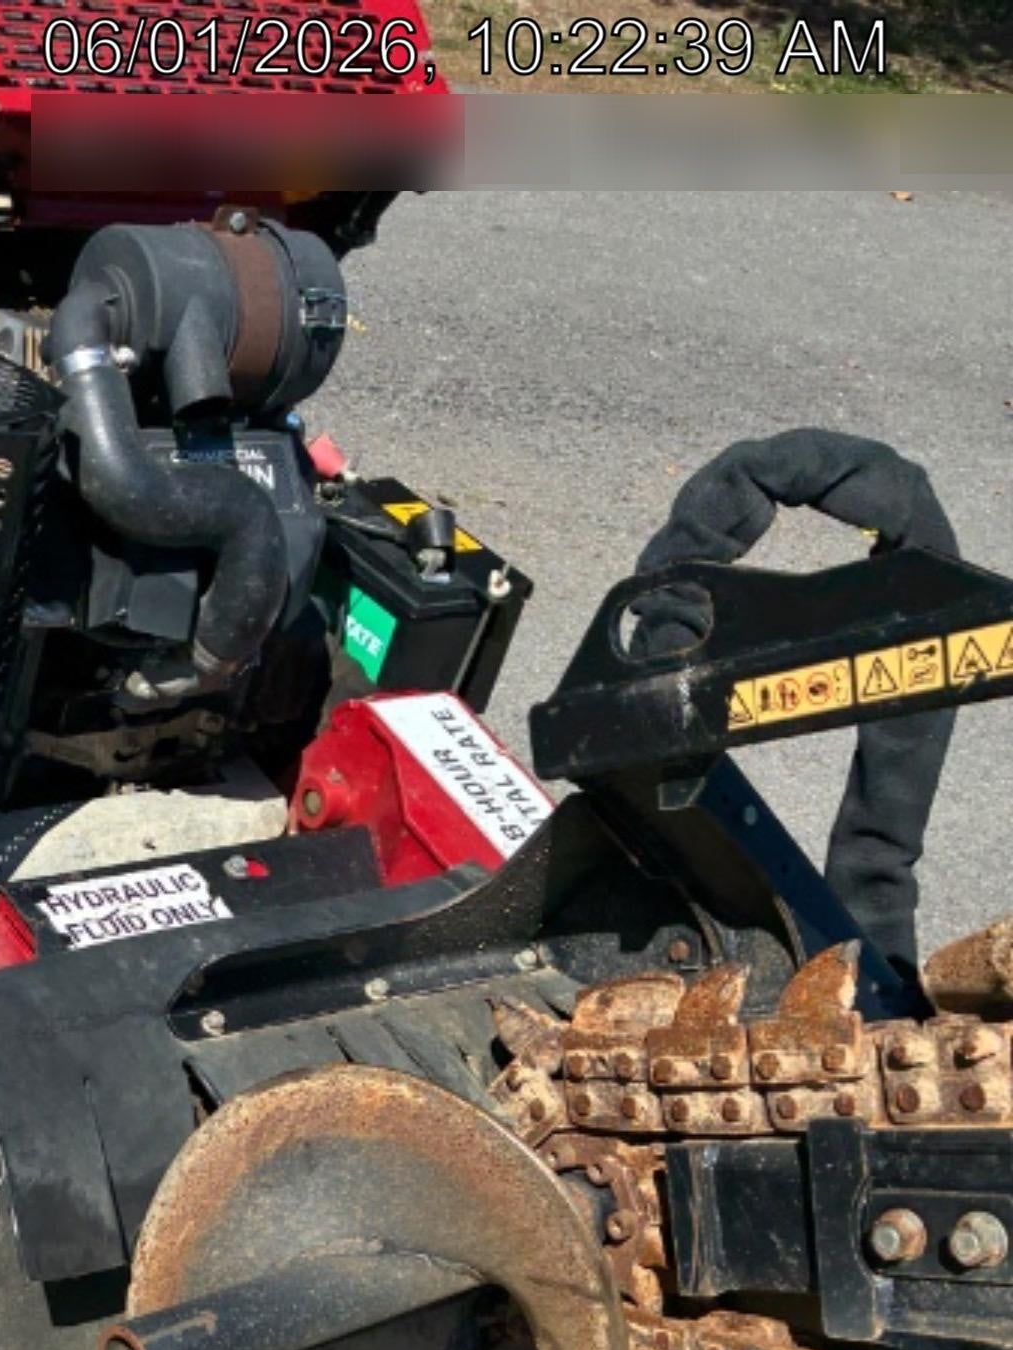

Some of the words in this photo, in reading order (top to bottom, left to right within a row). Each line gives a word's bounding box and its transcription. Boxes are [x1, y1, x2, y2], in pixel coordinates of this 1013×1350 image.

[431, 708, 497, 766] RATE
[44, 872, 201, 915] HYDRAULIC
[65, 910, 147, 943] FLUID
[151, 899, 219, 926] ONLY
